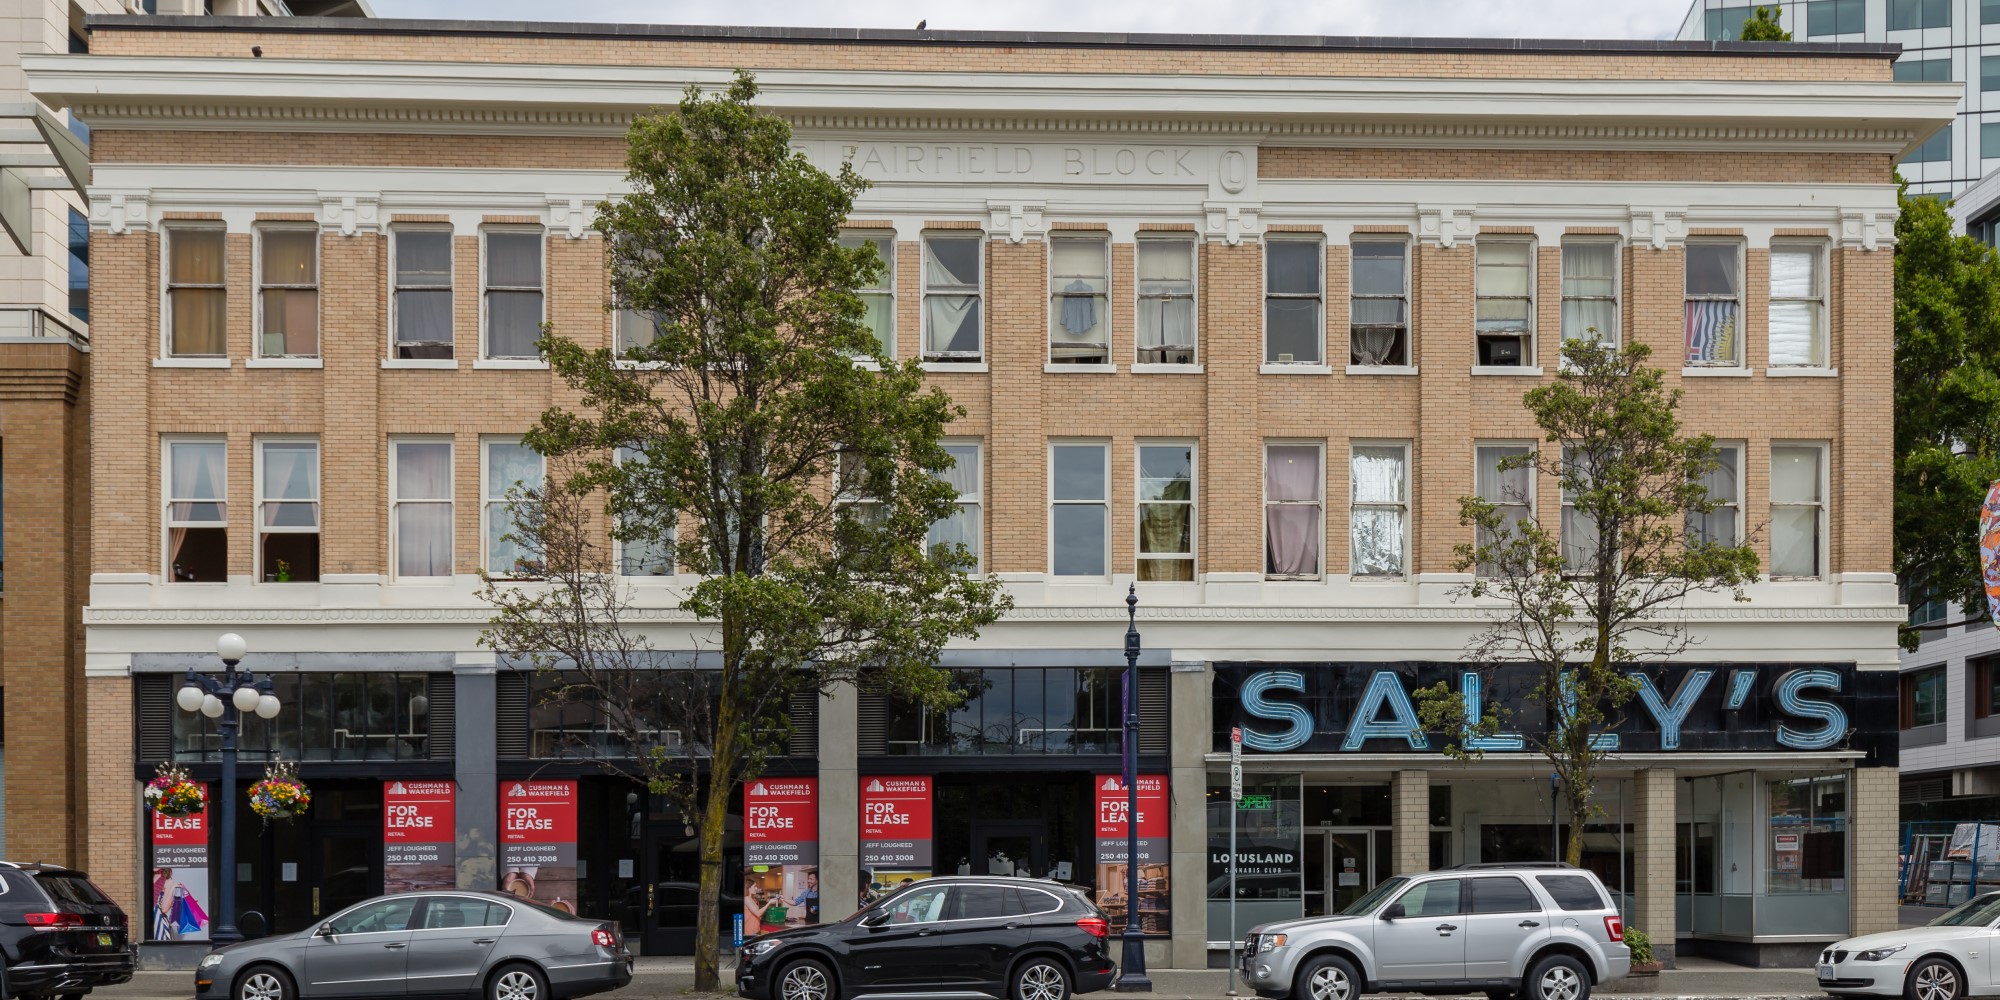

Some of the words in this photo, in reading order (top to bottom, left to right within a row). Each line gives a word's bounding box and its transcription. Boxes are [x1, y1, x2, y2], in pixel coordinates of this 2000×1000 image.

[1065, 148, 1195, 176] BLOCK
[1101, 802, 1129, 811] FOR
[1236, 796, 1272, 808] OPEN
[388, 806, 417, 816] FOR
[508, 808, 537, 818] FOR
[750, 807, 778, 817] FOR
[866, 803, 894, 813] FOR
[388, 817, 433, 827] LEASE
[866, 814, 909, 824] LEASE
[1101, 813, 1144, 822] LEAE
[156, 819, 201, 829] LEASE
[508, 819, 552, 830] LEASE
[750, 818, 793, 828] LEASE
